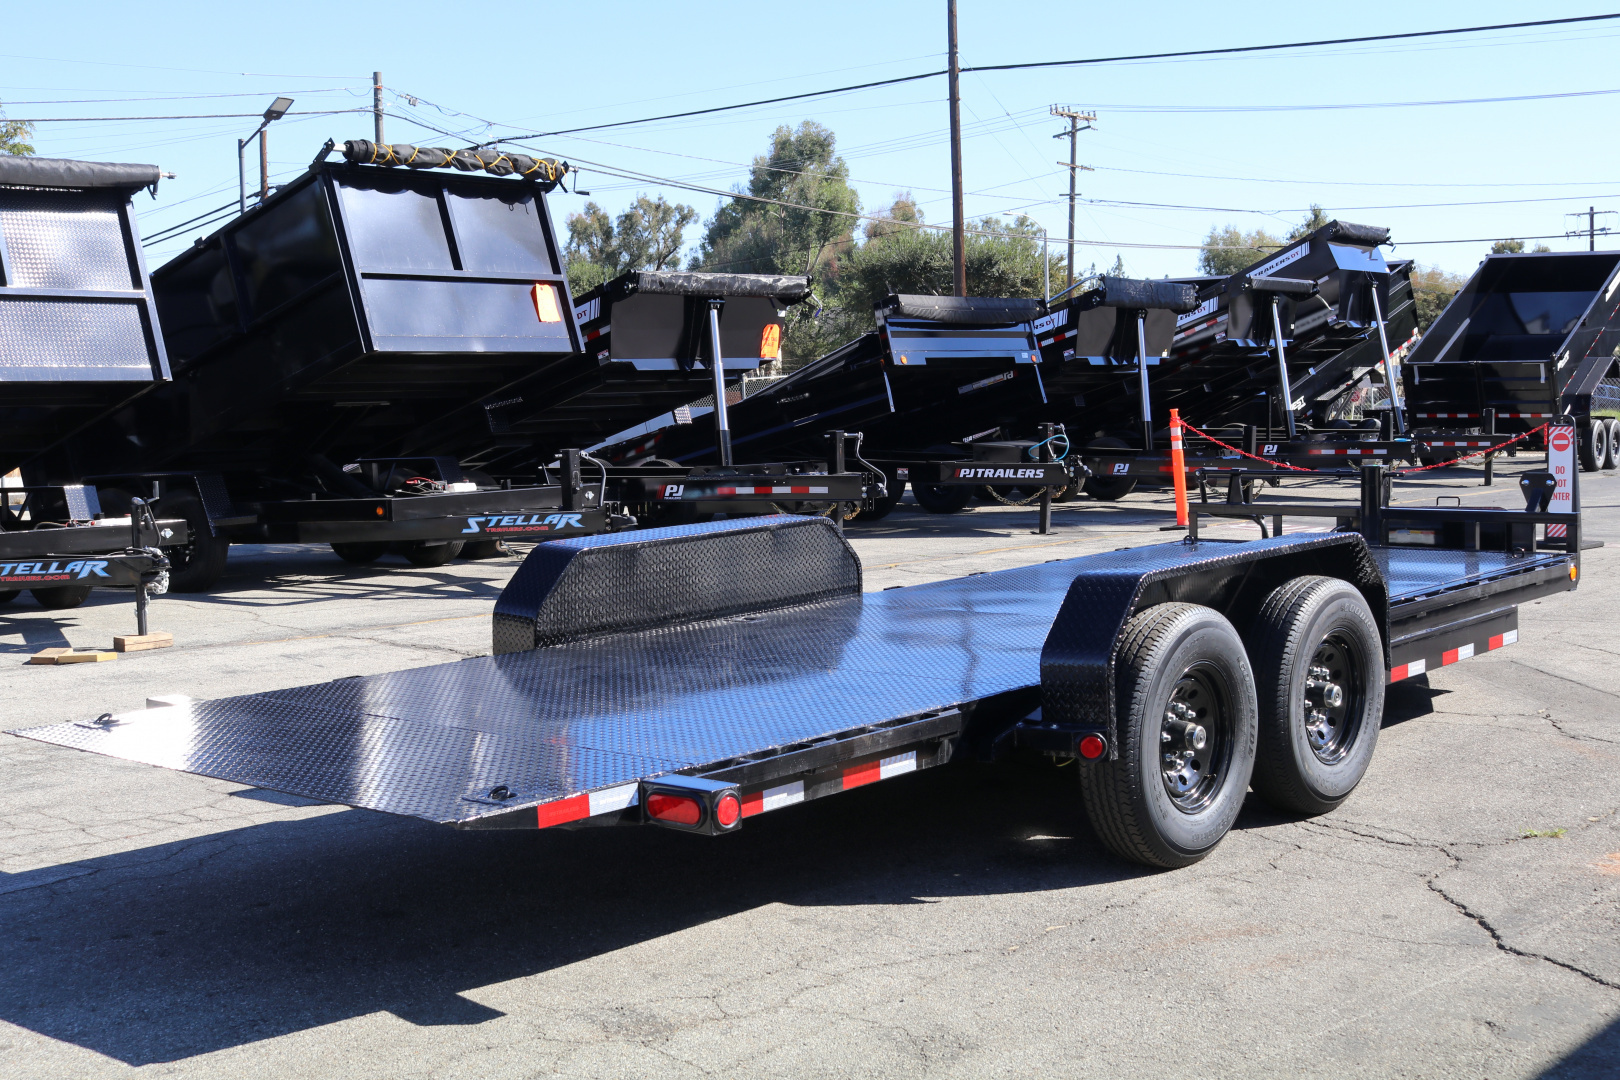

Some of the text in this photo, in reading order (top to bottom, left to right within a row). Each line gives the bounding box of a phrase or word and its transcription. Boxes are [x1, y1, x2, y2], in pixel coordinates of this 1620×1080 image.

[576, 309, 588, 320] DT
[1263, 444, 1278, 453] PJ
[960, 468, 1045, 479] PJ TRAILERS
[1113, 463, 1129, 473] PJ
[1555, 465, 1565, 474] DO
[664, 484, 684, 497] PJ
[461, 513, 585, 533] STELLAR
[485, 525, 549, 533] TRAILERS.COM
[0, 560, 112, 580] TELLAR
